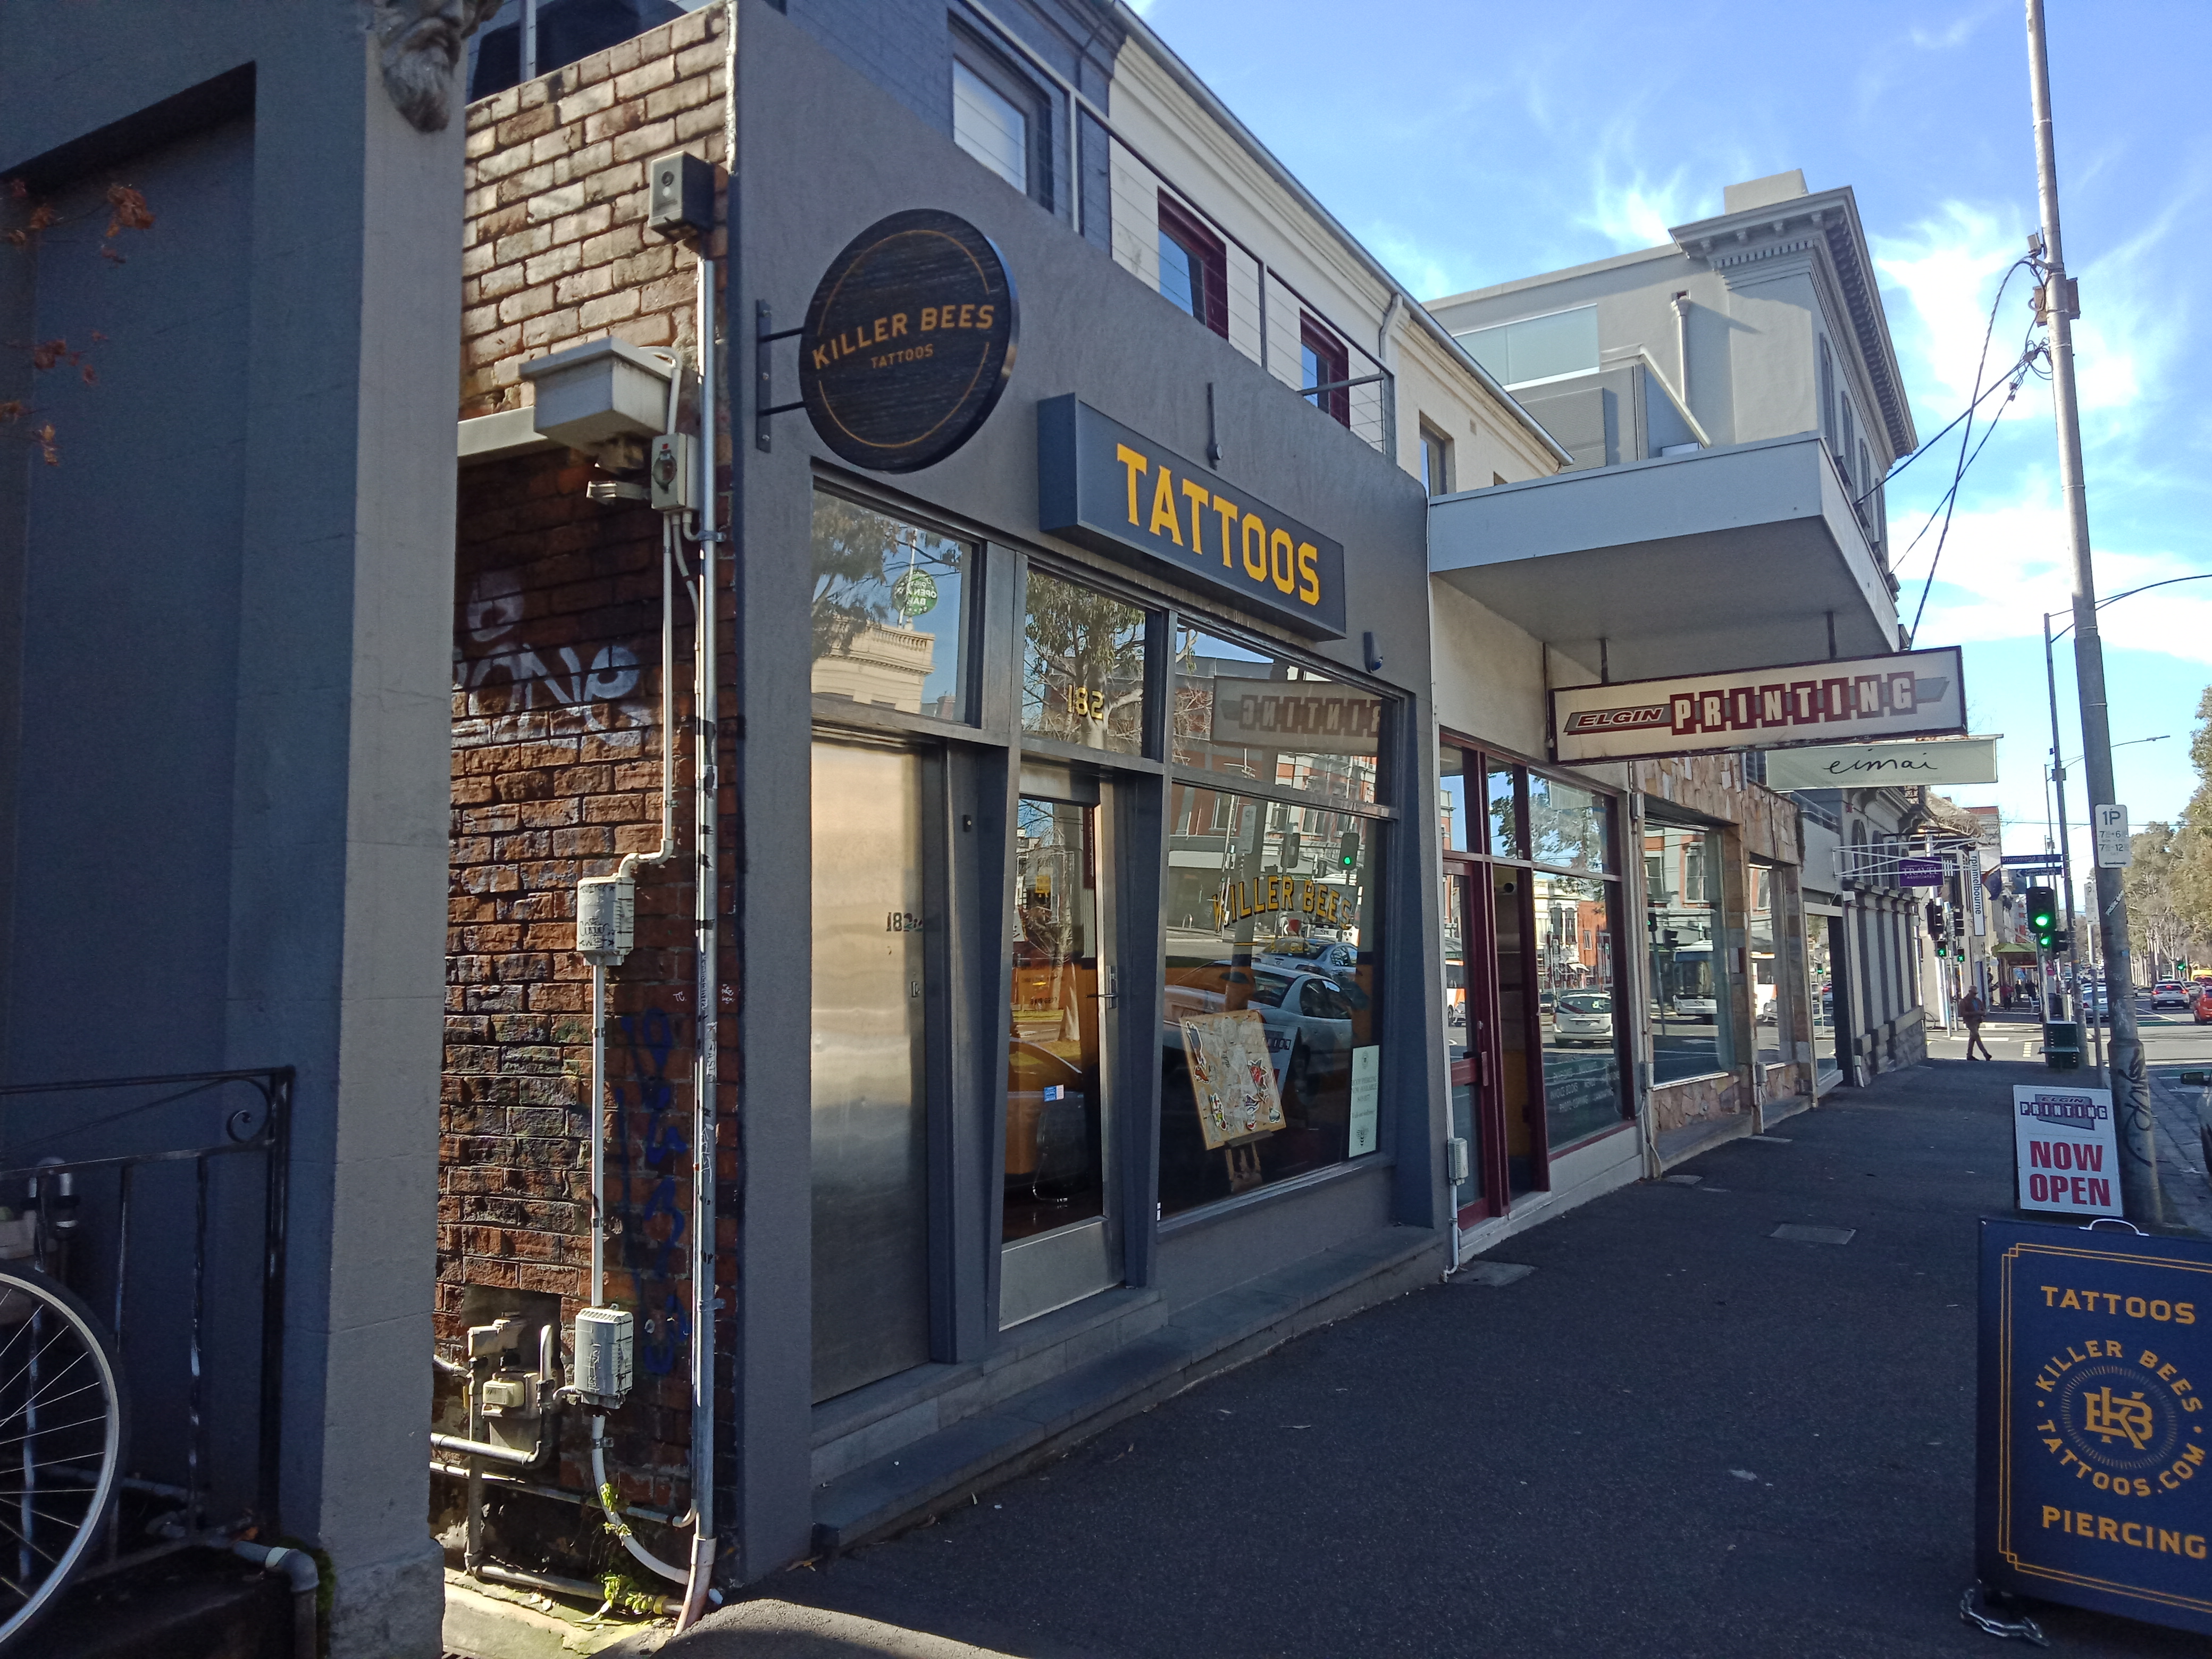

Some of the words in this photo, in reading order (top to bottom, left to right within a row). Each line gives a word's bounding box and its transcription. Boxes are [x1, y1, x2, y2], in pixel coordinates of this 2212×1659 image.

[811, 313, 908, 370] KILLER
[920, 304, 994, 331] BEES
[870, 344, 933, 368] TATTOOS
[1117, 443, 1320, 606] TATTOOS
[1067, 684, 1104, 719] 182
[1576, 708, 1663, 728] ELGIN
[1674, 677, 1913, 730] PRINTING
[1823, 748, 1938, 774] eimai
[2102, 809, 2121, 825] 1P
[1901, 867, 1939, 876] TRAVEL
[1303, 879, 1352, 931] BEES
[2021, 1103, 2106, 1120] PRINTING
[2030, 1141, 2102, 1172] NOW
[2030, 1174, 2110, 1206] OPEN
[2041, 1285, 2196, 1324] TATTOOS
[2035, 1339, 2122, 1392] KILLER
[2138, 1350, 2202, 1412] BEES
[2042, 1505, 2207, 1559] PIERCING
